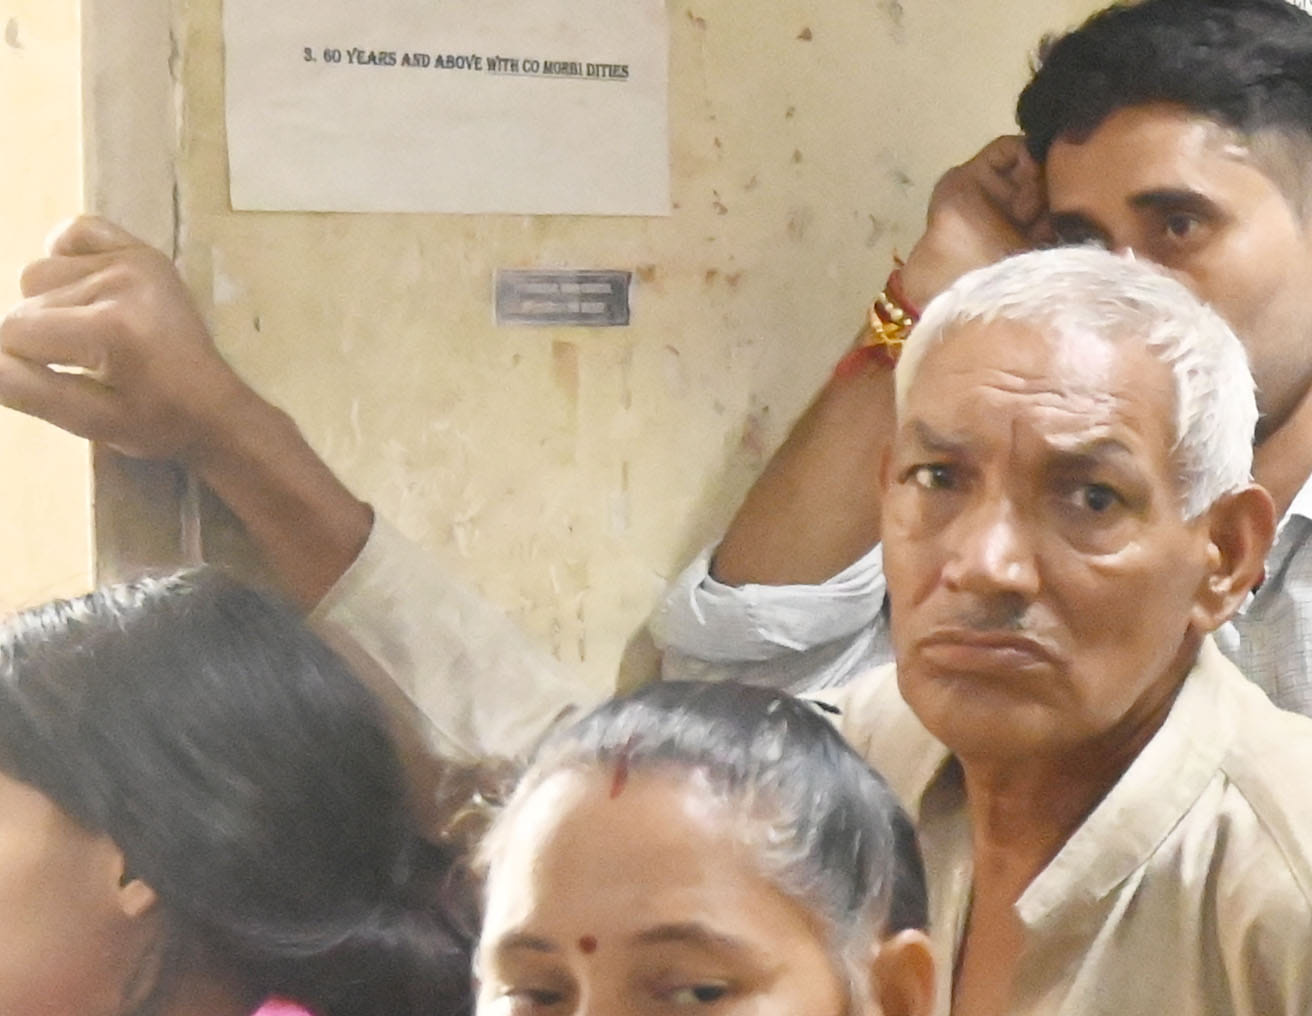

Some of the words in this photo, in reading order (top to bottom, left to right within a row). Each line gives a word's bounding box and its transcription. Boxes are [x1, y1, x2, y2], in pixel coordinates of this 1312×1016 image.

[323, 48, 342, 63] 60
[346, 49, 397, 67] YEARS
[400, 53, 431, 69] AND
[434, 54, 484, 72] ABOVE
[486, 56, 519, 74] WITH
[522, 59, 540, 75] CO
[586, 62, 630, 80] DITIES
